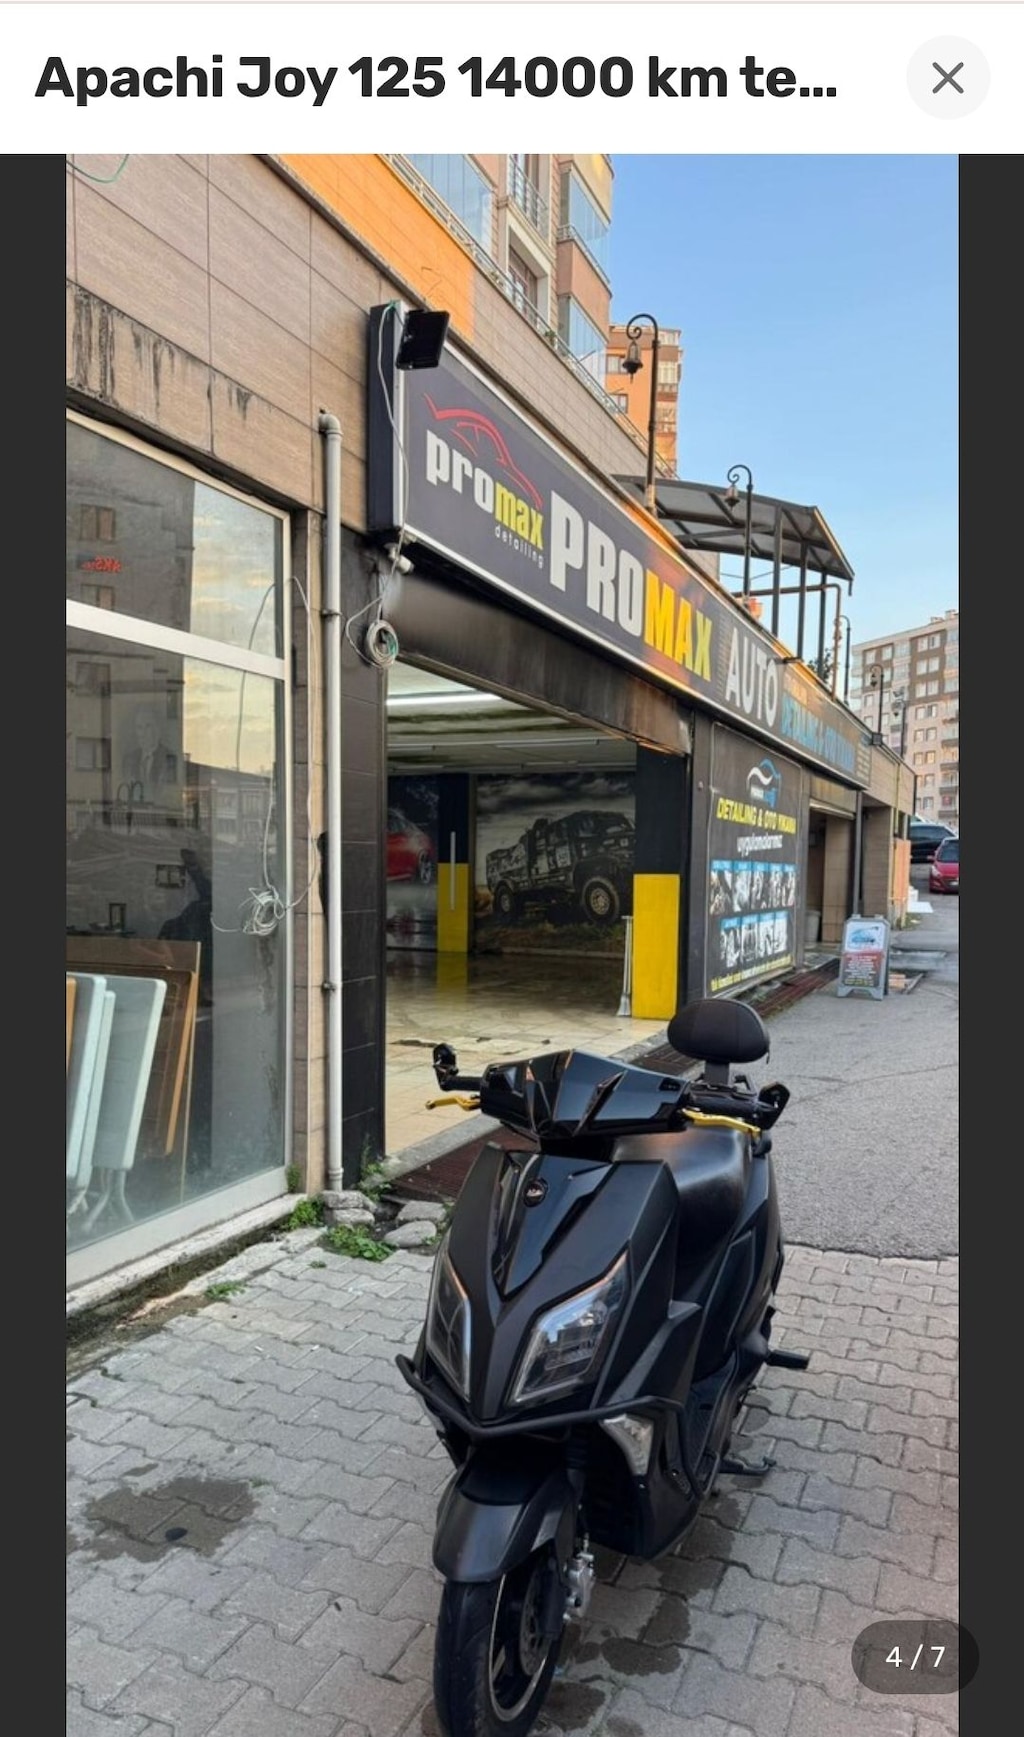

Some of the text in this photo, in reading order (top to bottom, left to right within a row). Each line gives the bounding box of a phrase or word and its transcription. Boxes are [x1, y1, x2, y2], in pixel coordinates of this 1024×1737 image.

[426, 429, 544, 550] promax
[495, 524, 544, 569] detailing
[550, 490, 713, 682] PROMAX
[725, 627, 779, 728] AUTO
[716, 796, 757, 826] DETAILING
